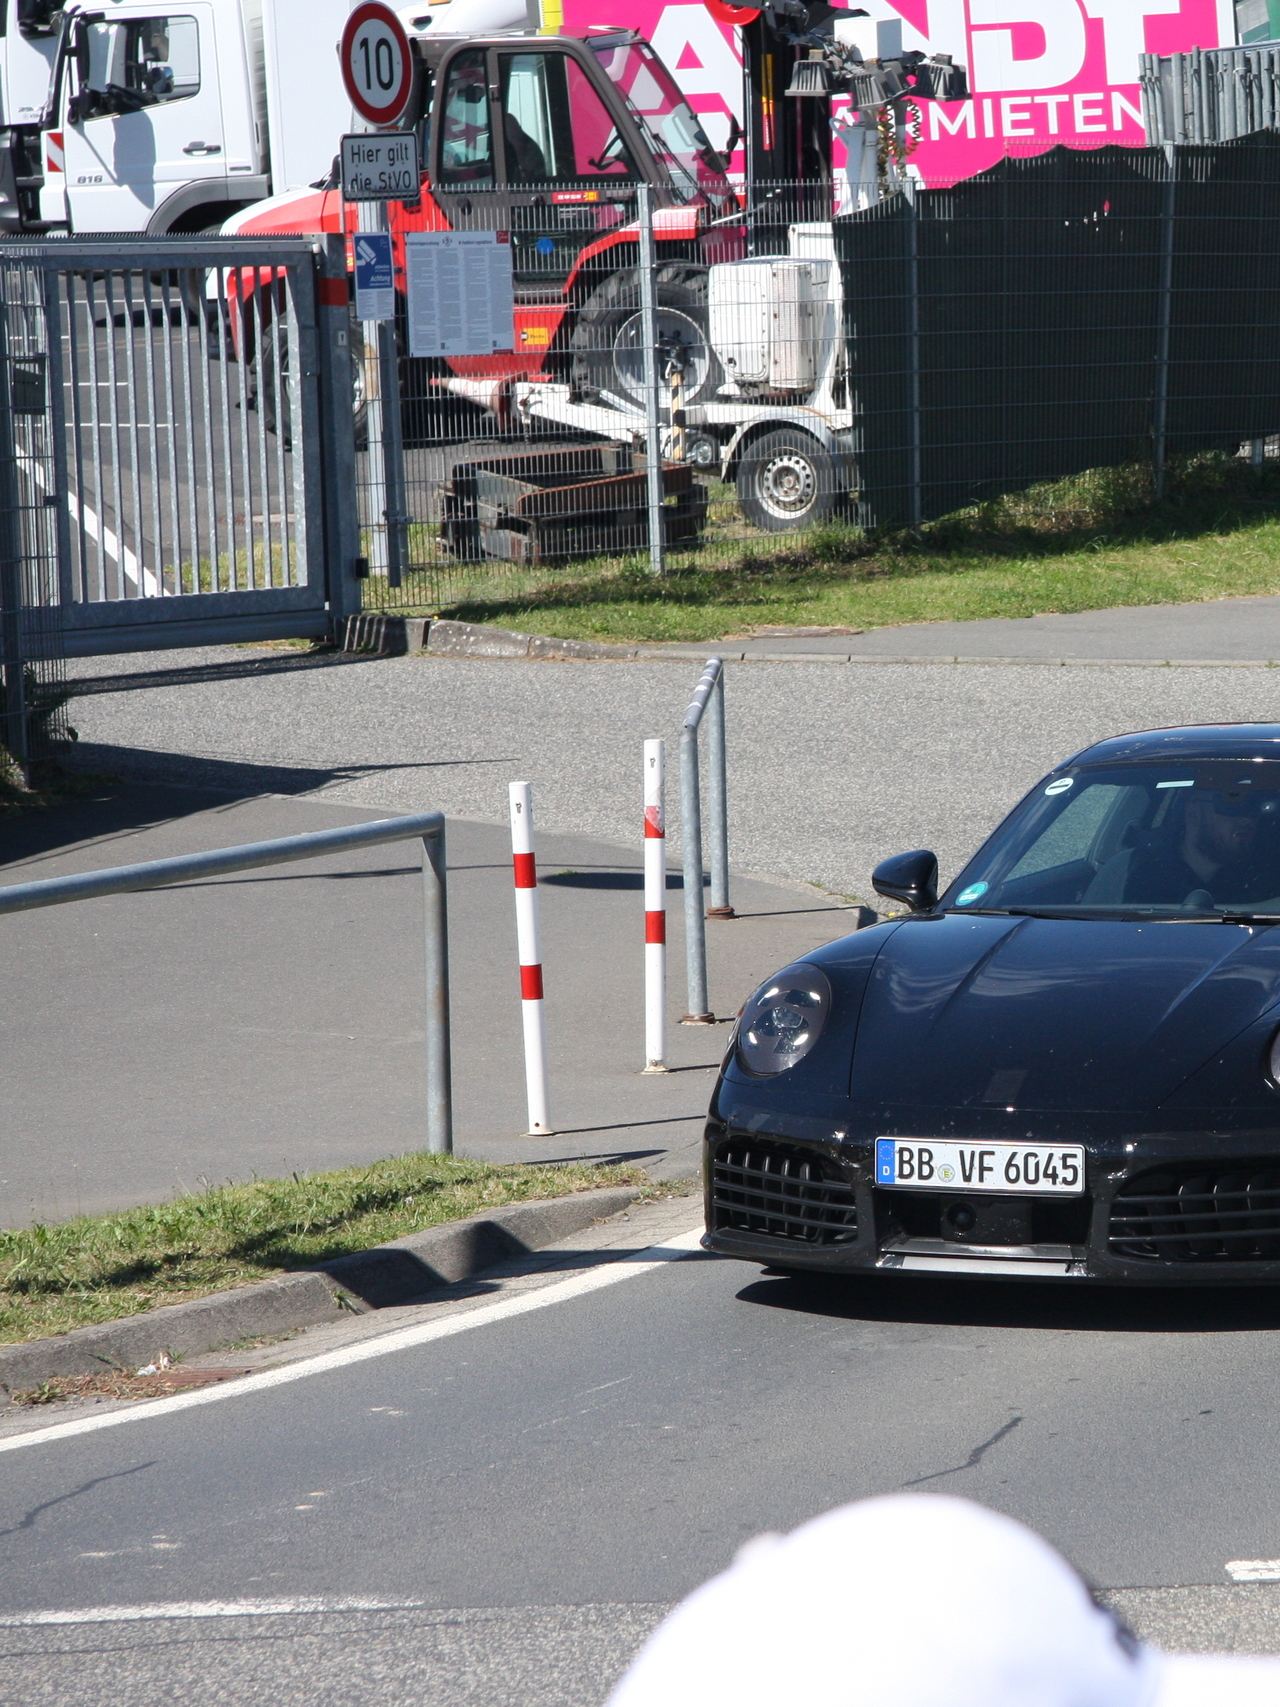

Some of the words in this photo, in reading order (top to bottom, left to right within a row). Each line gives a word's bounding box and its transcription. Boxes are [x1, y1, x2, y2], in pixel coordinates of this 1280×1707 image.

[359, 37, 394, 91] 10
[351, 144, 381, 163] Hier
[387, 142, 409, 166] gilt
[350, 172, 372, 190] die
[378, 170, 411, 190] StVO
[882, 1165, 891, 1176] D
[898, 1146, 934, 1180] BB
[959, 1149, 995, 1183] VF
[1004, 1151, 1079, 1186] 6045
